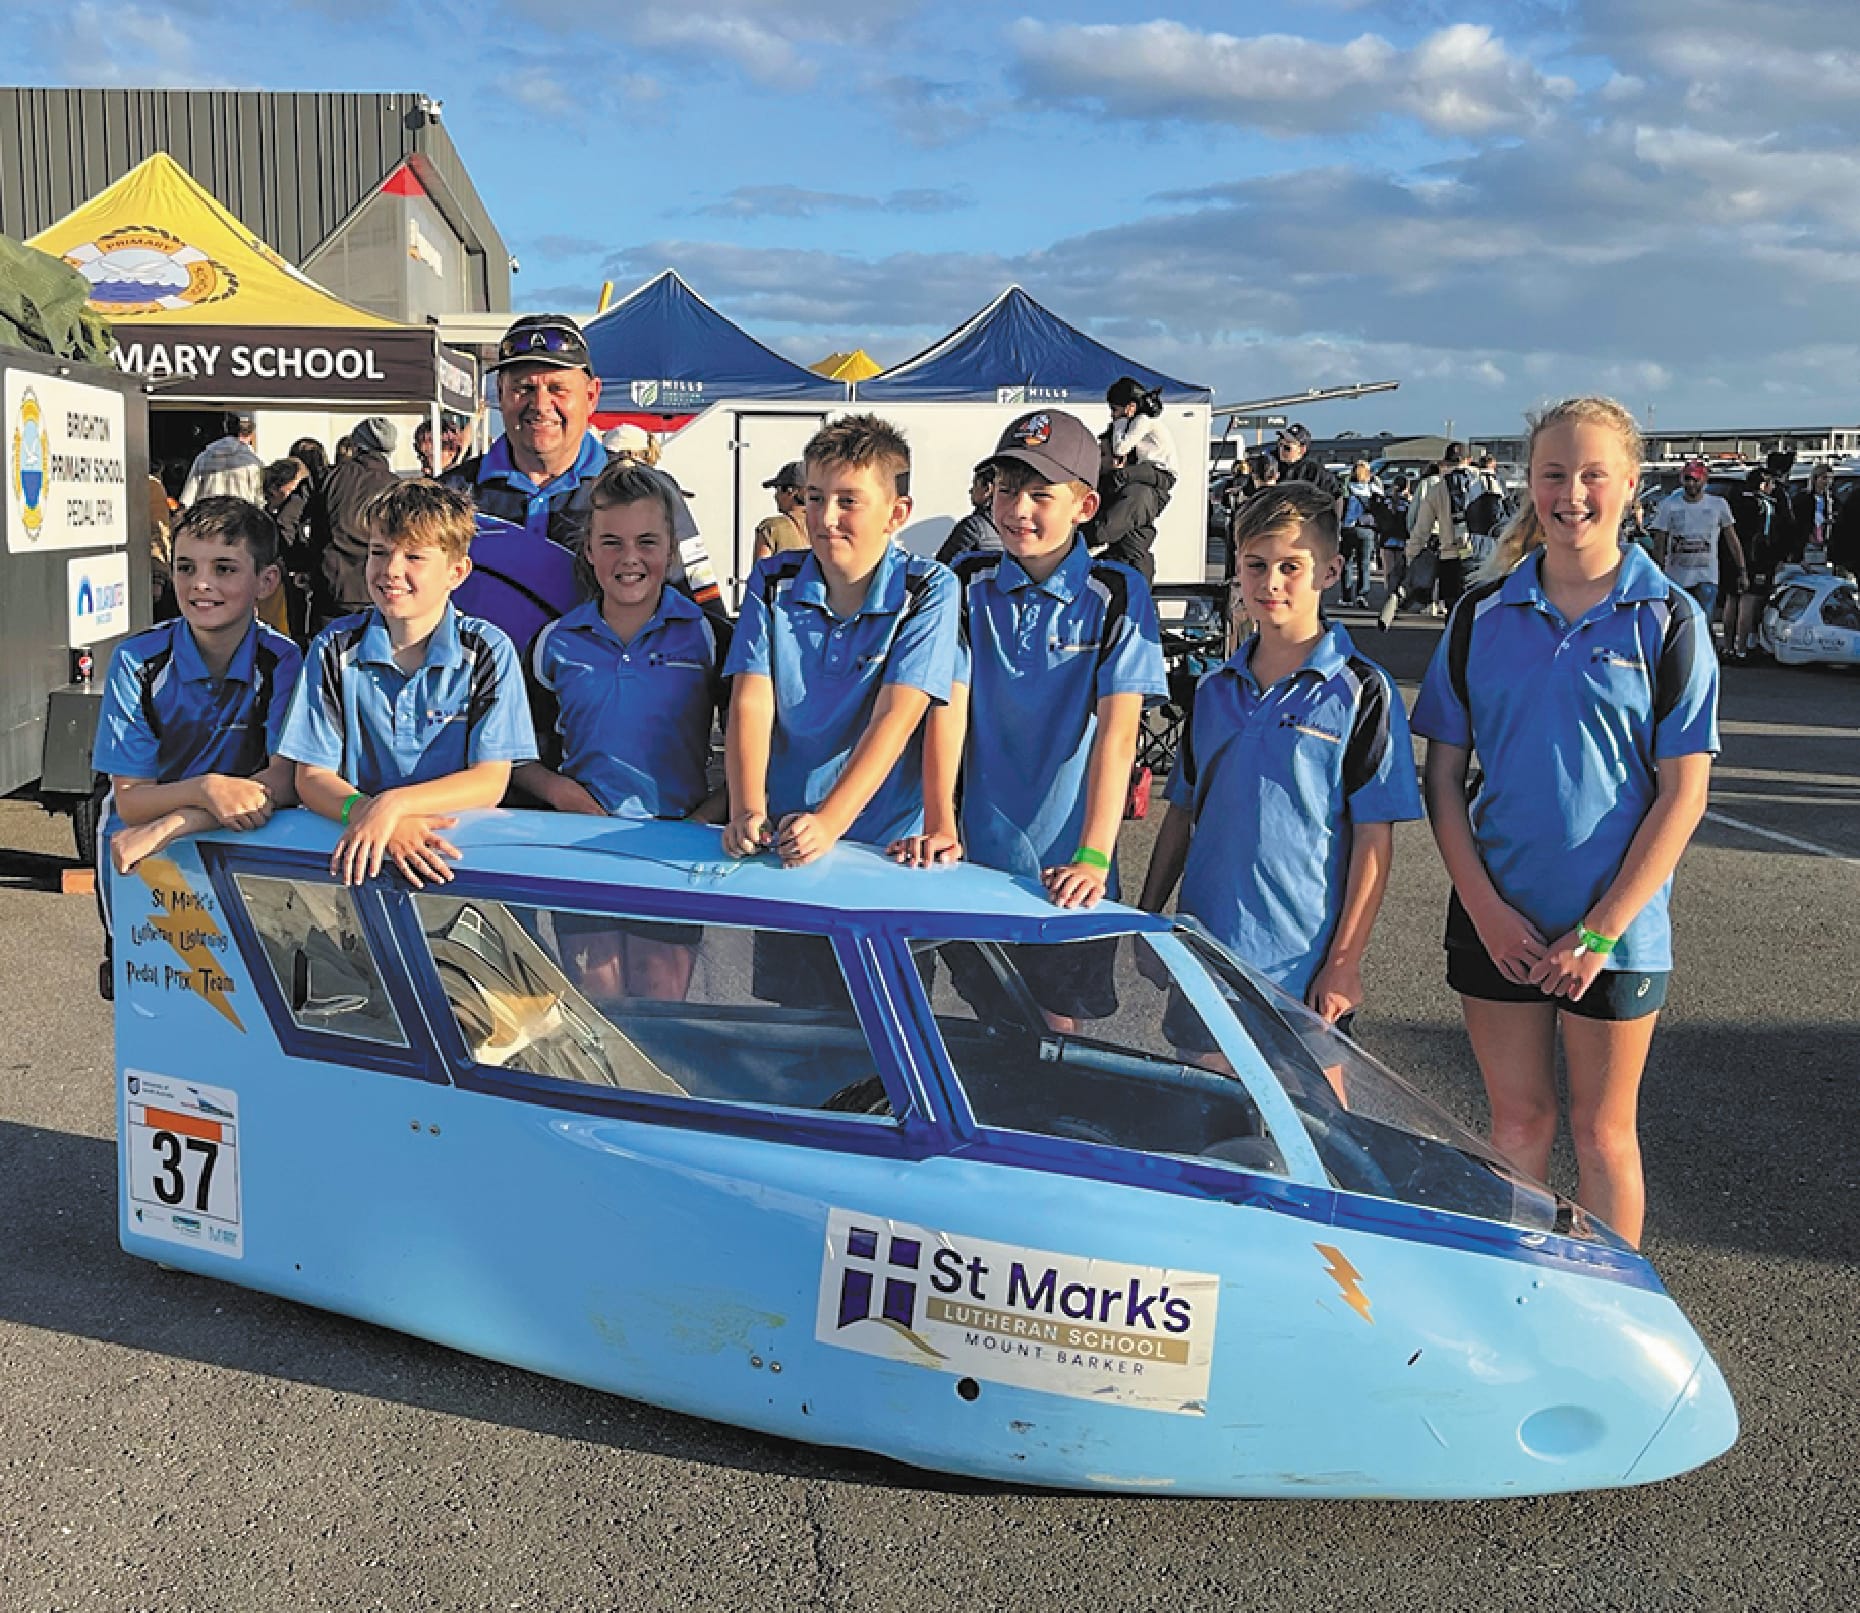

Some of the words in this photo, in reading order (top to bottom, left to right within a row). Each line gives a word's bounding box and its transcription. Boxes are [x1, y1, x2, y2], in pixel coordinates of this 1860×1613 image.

[231, 347, 385, 379] SCHOOL
[662, 380, 703, 392] HILLS
[1029, 388, 1069, 398] HILLS
[66, 411, 111, 441] BRIGHTON
[51, 454, 92, 482] PRIMARY
[93, 457, 124, 484] SCHOOL
[66, 499, 95, 526] PEDAL
[152, 888, 166, 908] St
[172, 891, 215, 912] Mark's
[180, 928, 229, 952] Lightning
[126, 960, 159, 989] Pedal
[164, 964, 191, 992] Prix
[198, 967, 235, 995] Team
[153, 1131, 218, 1212] 37
[930, 1248, 989, 1300] St
[1007, 1262, 1191, 1333] Mark's
[943, 1303, 1058, 1341] LUTHERAN
[1068, 1329, 1166, 1358] SCHOOL
[964, 1331, 1043, 1359] MOUNT
[1057, 1350, 1145, 1376] BARKER
